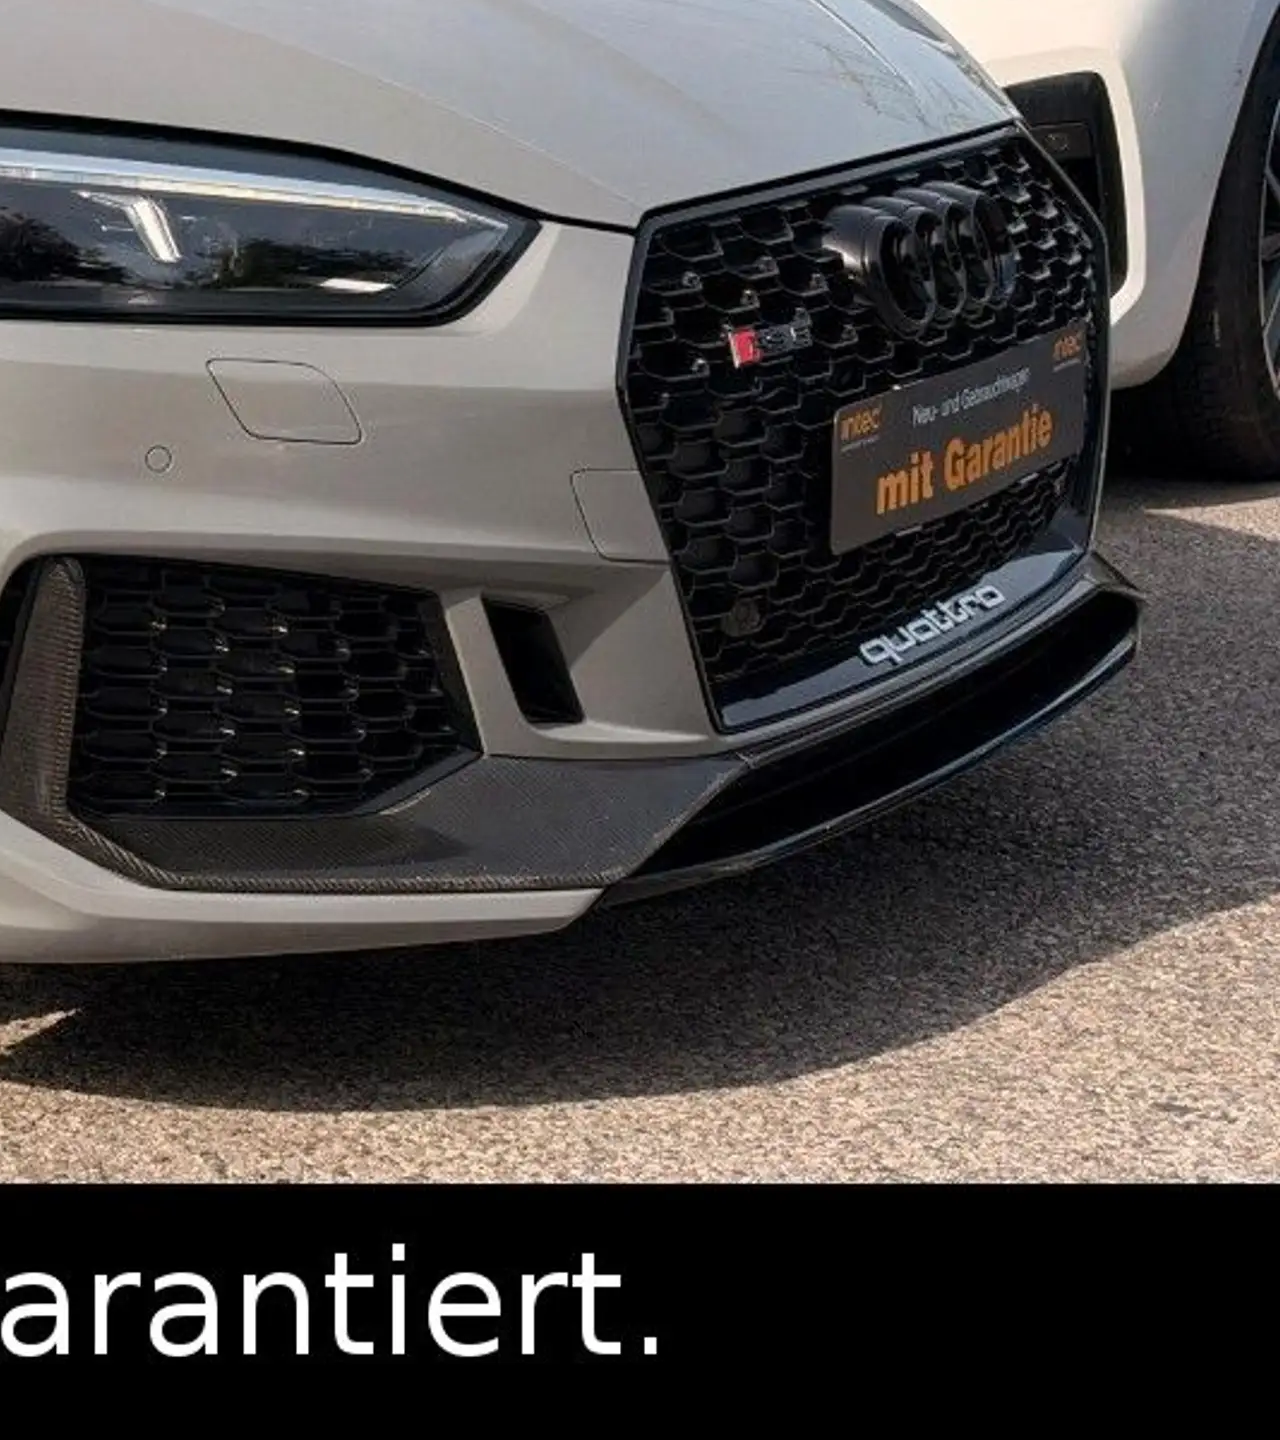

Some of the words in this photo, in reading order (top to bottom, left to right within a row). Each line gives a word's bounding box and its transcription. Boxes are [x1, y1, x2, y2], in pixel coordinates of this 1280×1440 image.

[876, 450, 934, 515] mit
[944, 403, 1054, 491] Garantie
[859, 584, 1007, 664] quattro
